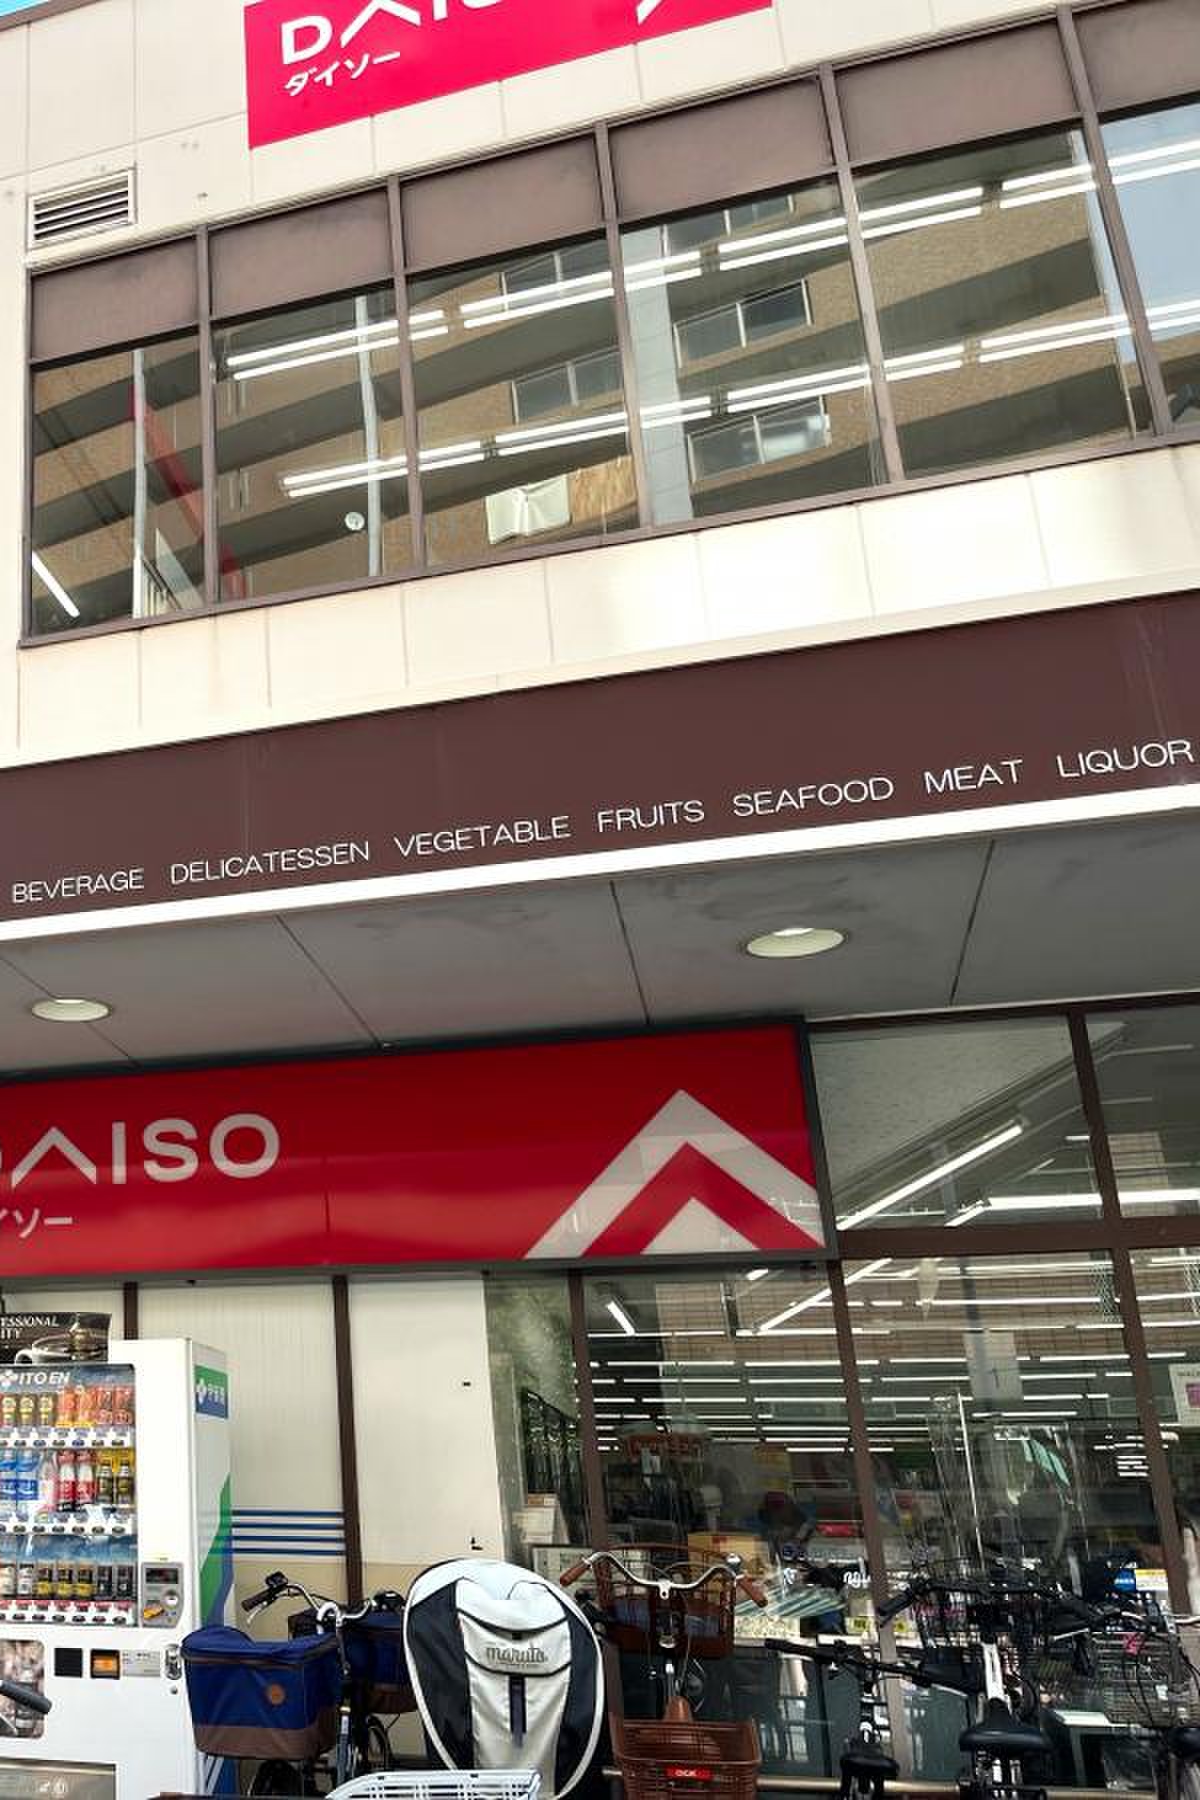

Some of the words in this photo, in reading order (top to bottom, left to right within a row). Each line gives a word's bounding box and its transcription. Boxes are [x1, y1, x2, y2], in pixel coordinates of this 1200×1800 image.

[281, 0, 500, 64] DA
[284, 51, 401, 97] ダイソー
[12, 867, 145, 904] BEVERAGE
[171, 841, 371, 885] DELICATESSEN
[394, 815, 572, 858] VEGETABLE
[597, 800, 706, 834] FRUITS
[733, 776, 895, 817] SEAFOOD
[924, 759, 1024, 794] MEAT
[1055, 739, 1195, 779] LIQUOR
